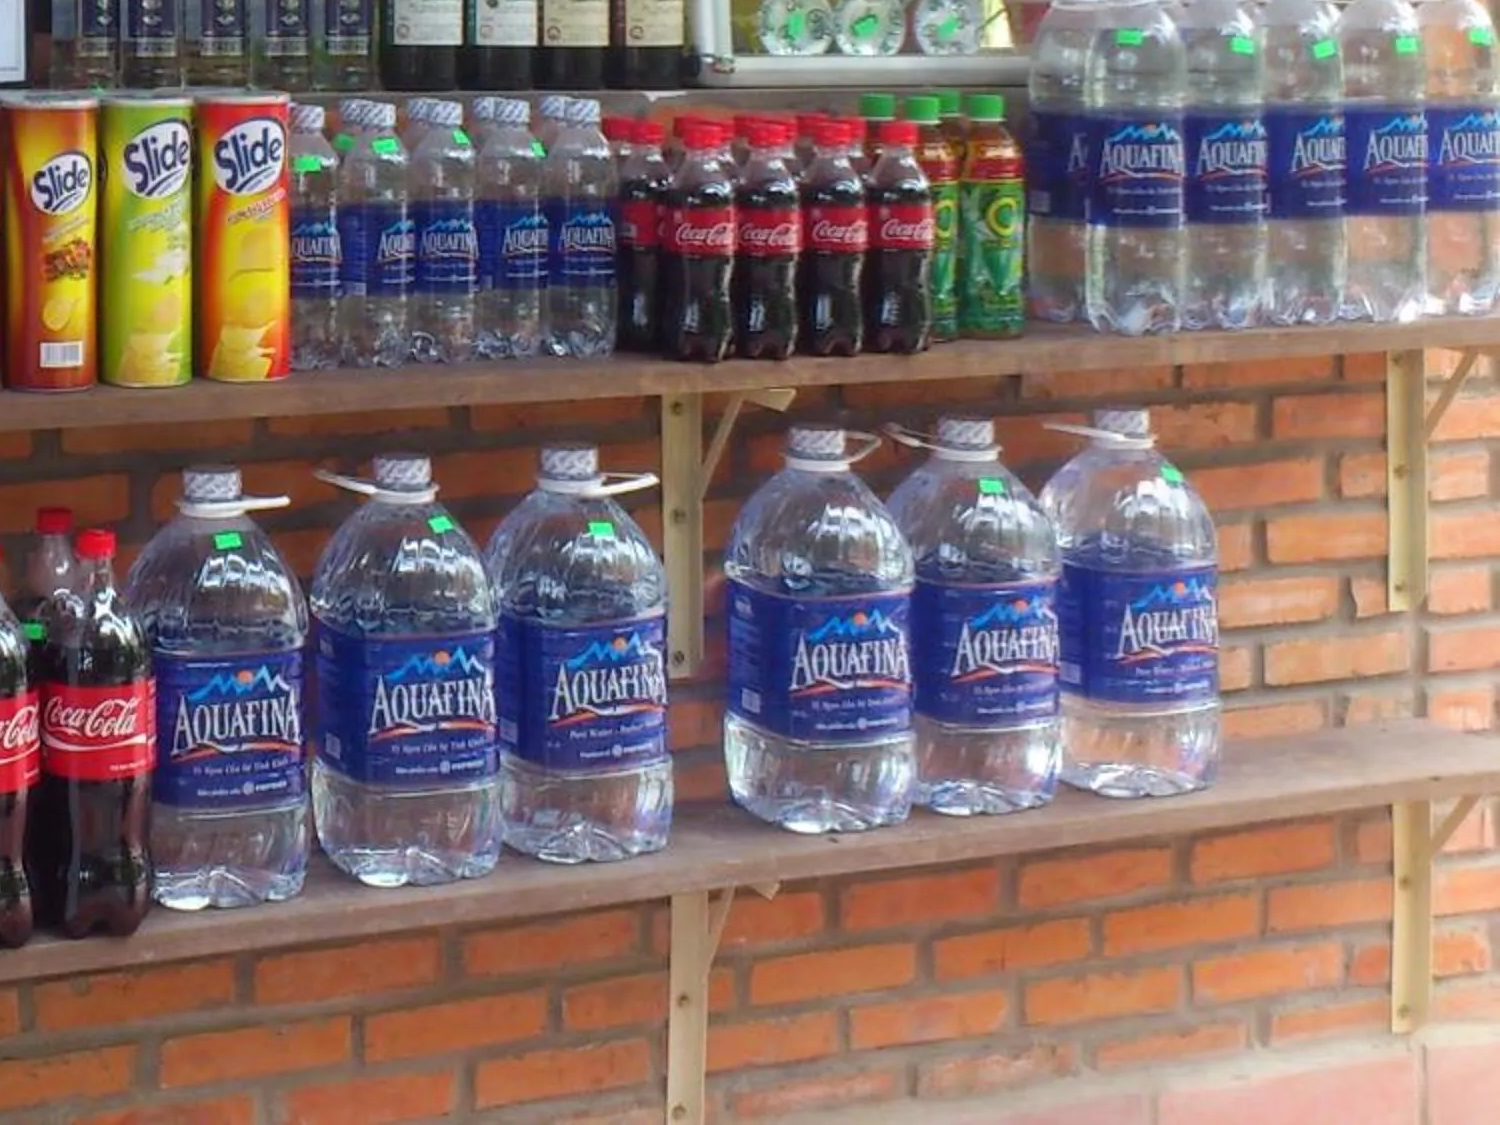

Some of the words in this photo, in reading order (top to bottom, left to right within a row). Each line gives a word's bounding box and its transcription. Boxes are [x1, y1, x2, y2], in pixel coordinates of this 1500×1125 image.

[34, 161, 89, 210] Slide
[122, 129, 190, 194] Slide
[213, 127, 283, 193] Slide
[788, 631, 912, 691] AQUAFINA
[950, 620, 1061, 678] AQUAFINA
[44, 696, 141, 738] Coca-Cola
[368, 671, 498, 735] AQUAFINA
[548, 660, 669, 721] AQUAFINA
[171, 688, 302, 755] AQUAFINA
